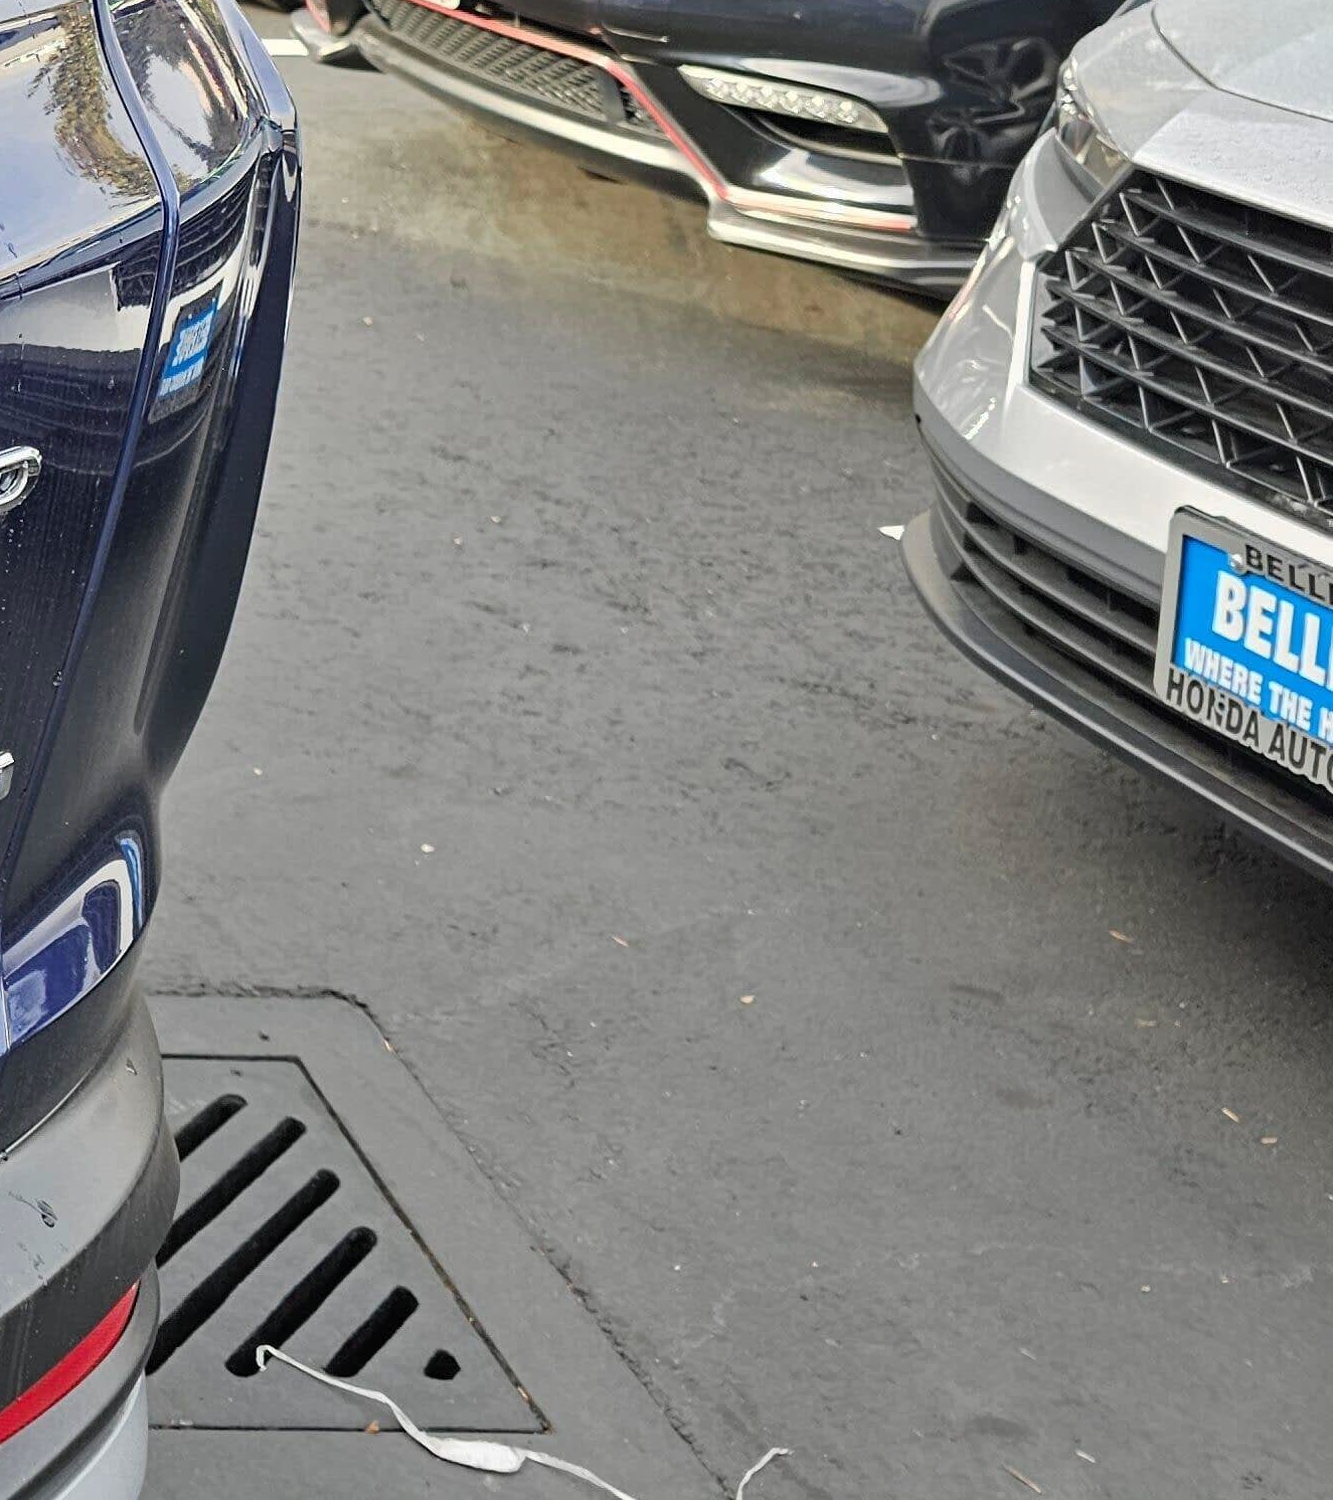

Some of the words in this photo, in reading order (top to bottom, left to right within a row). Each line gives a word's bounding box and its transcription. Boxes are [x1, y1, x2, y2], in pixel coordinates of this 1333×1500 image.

[1212, 570, 1333, 691] BELL
[1167, 668, 1259, 748] HONDA
[1185, 637, 1263, 706] WHERE
[1269, 681, 1312, 732] THE
